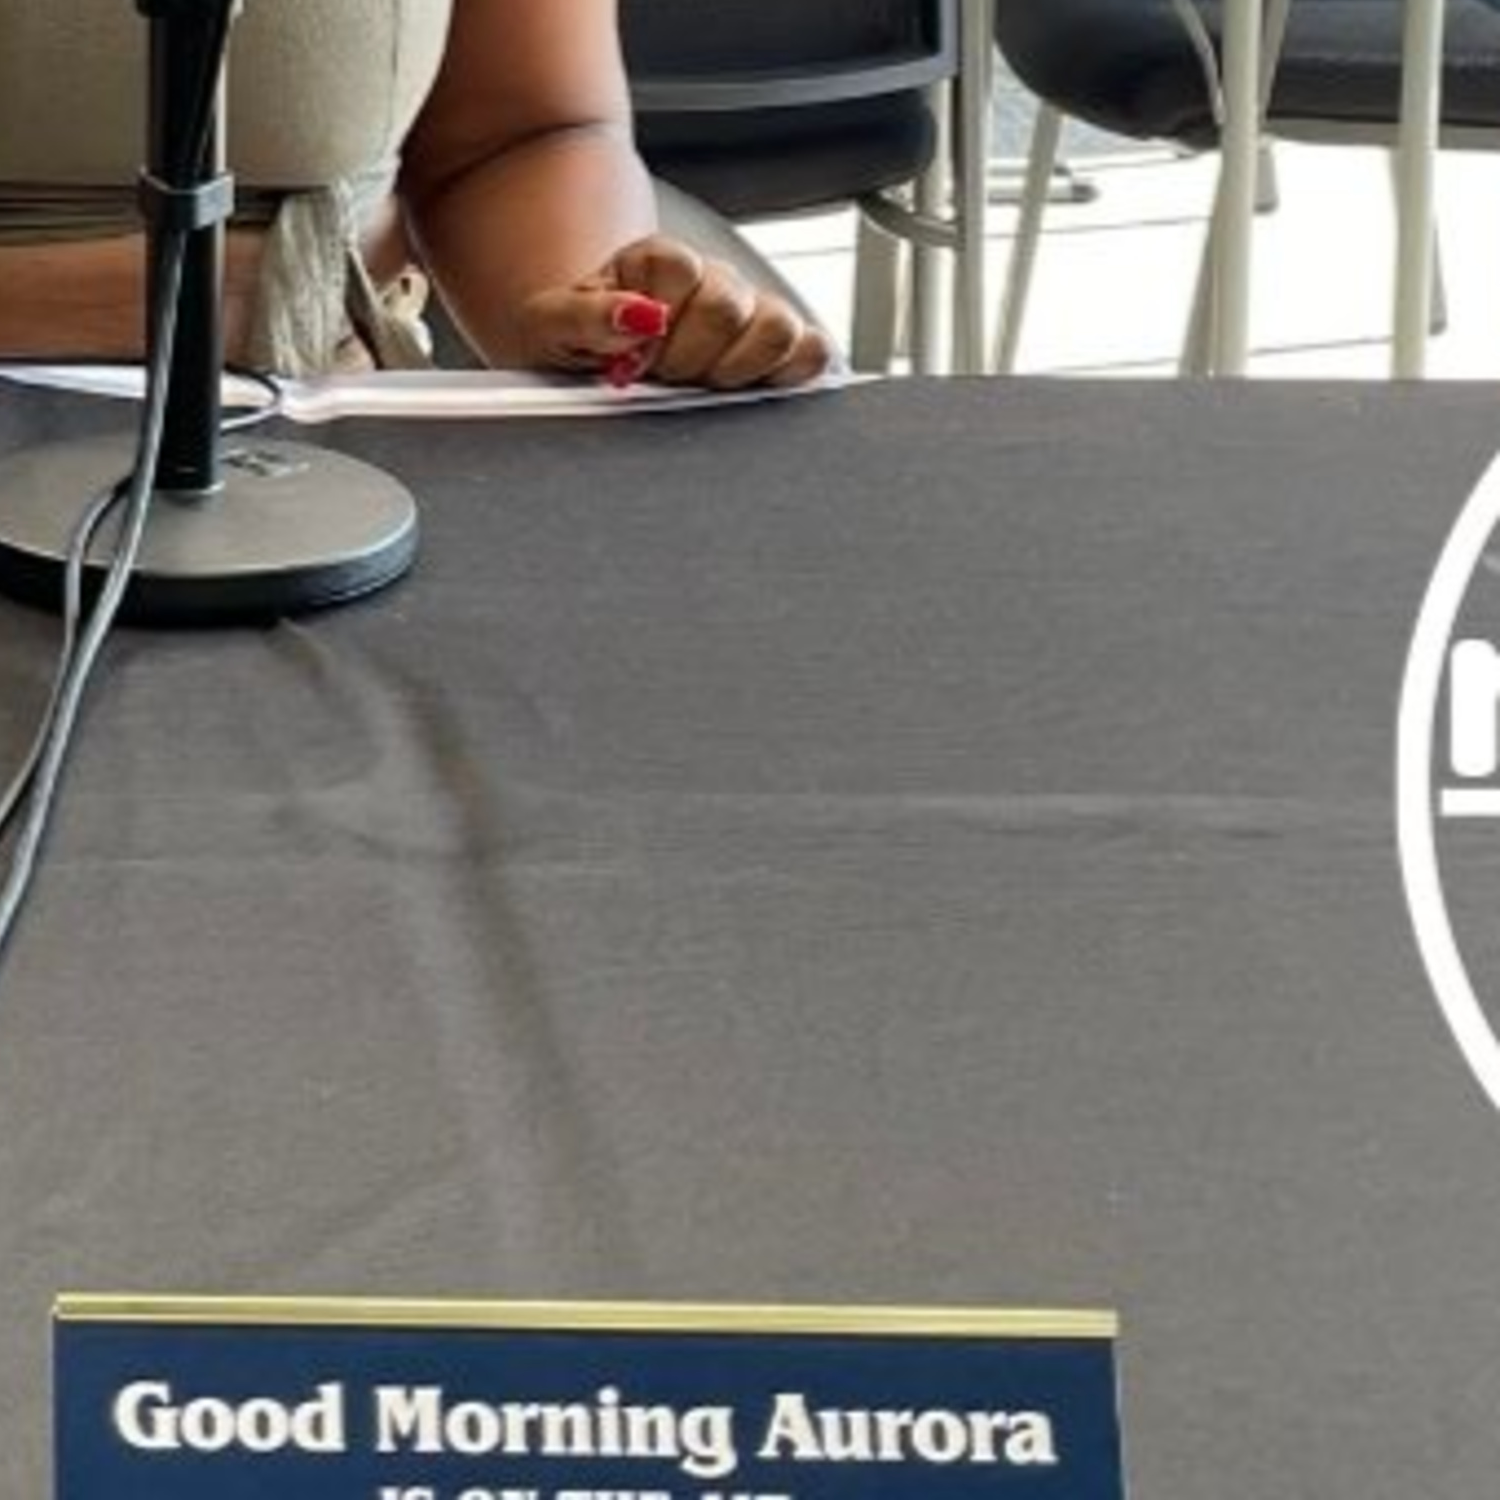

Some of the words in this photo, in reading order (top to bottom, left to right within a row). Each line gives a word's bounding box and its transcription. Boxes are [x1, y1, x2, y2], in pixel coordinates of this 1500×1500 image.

[112, 1381, 345, 1451] Good
[374, 1386, 736, 1477] Morning
[756, 1393, 1057, 1464] Aurora
